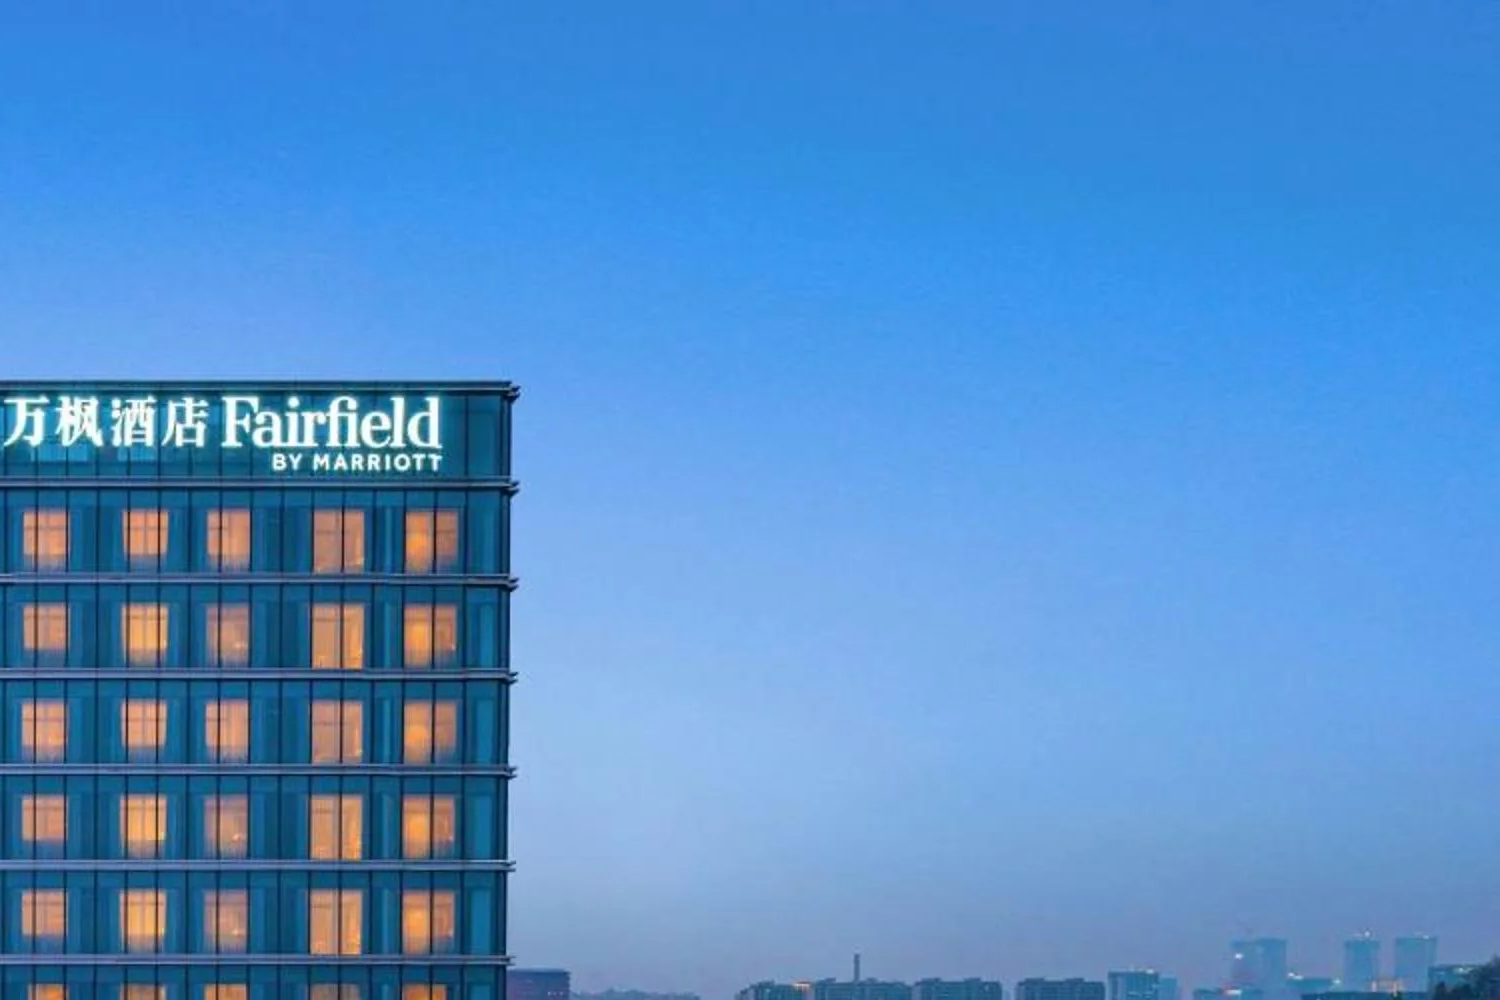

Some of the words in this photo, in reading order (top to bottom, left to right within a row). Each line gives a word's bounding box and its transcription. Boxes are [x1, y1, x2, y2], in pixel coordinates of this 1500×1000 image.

[4, 396, 208, 447] 万枫酒店
[222, 396, 443, 449] Fairfield
[272, 453, 302, 471] BY
[313, 453, 443, 471] MARRIOTT
